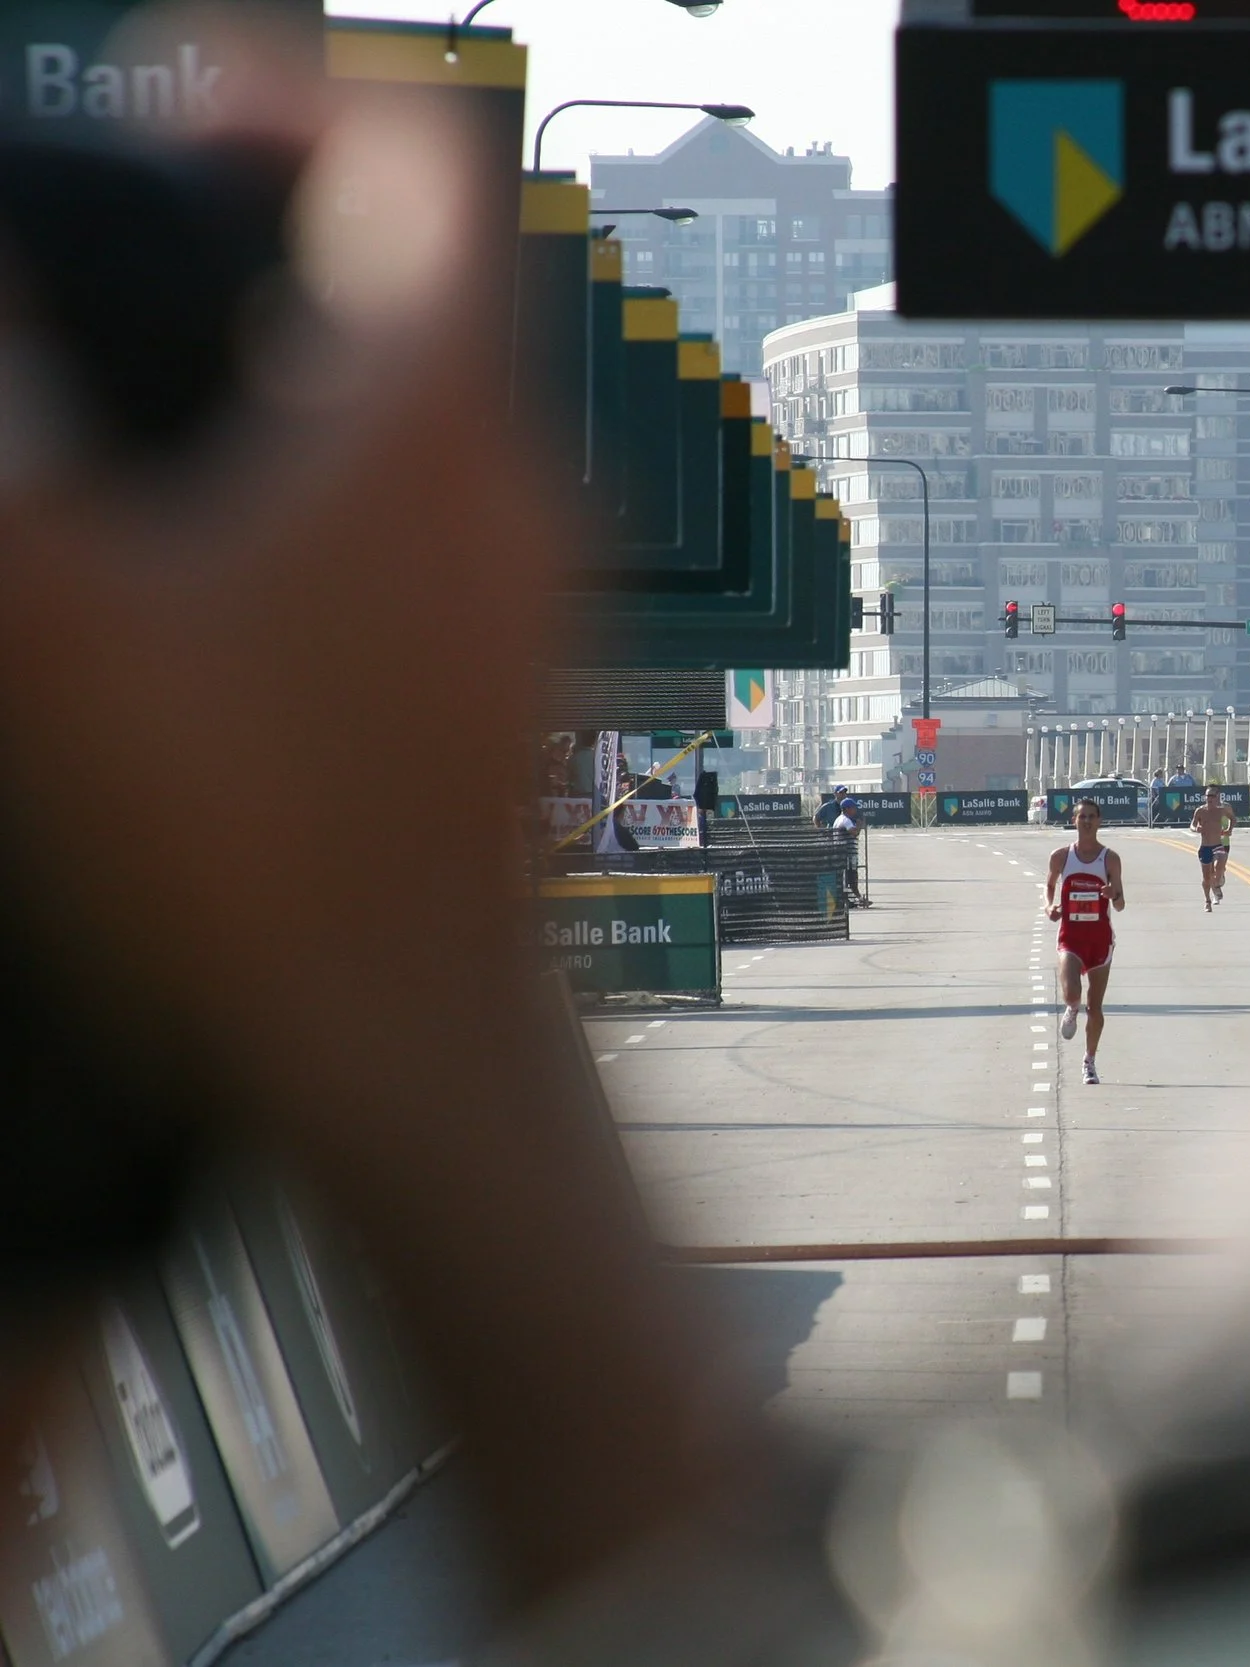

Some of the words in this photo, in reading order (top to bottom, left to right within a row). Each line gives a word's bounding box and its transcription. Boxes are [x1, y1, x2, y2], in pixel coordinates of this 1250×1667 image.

[25, 44, 222, 118] Bank
[919, 753, 935, 765] 90
[918, 772, 934, 784] 94
[1107, 795, 1130, 805] Bank
[1220, 792, 1242, 802] Bank
[772, 801, 795, 811] Bank
[881, 799, 904, 809] Bank
[962, 798, 996, 808] LaSalle
[997, 798, 1020, 807] Bank
[735, 870, 771, 896] Bank
[611, 918, 673, 945] Bank
